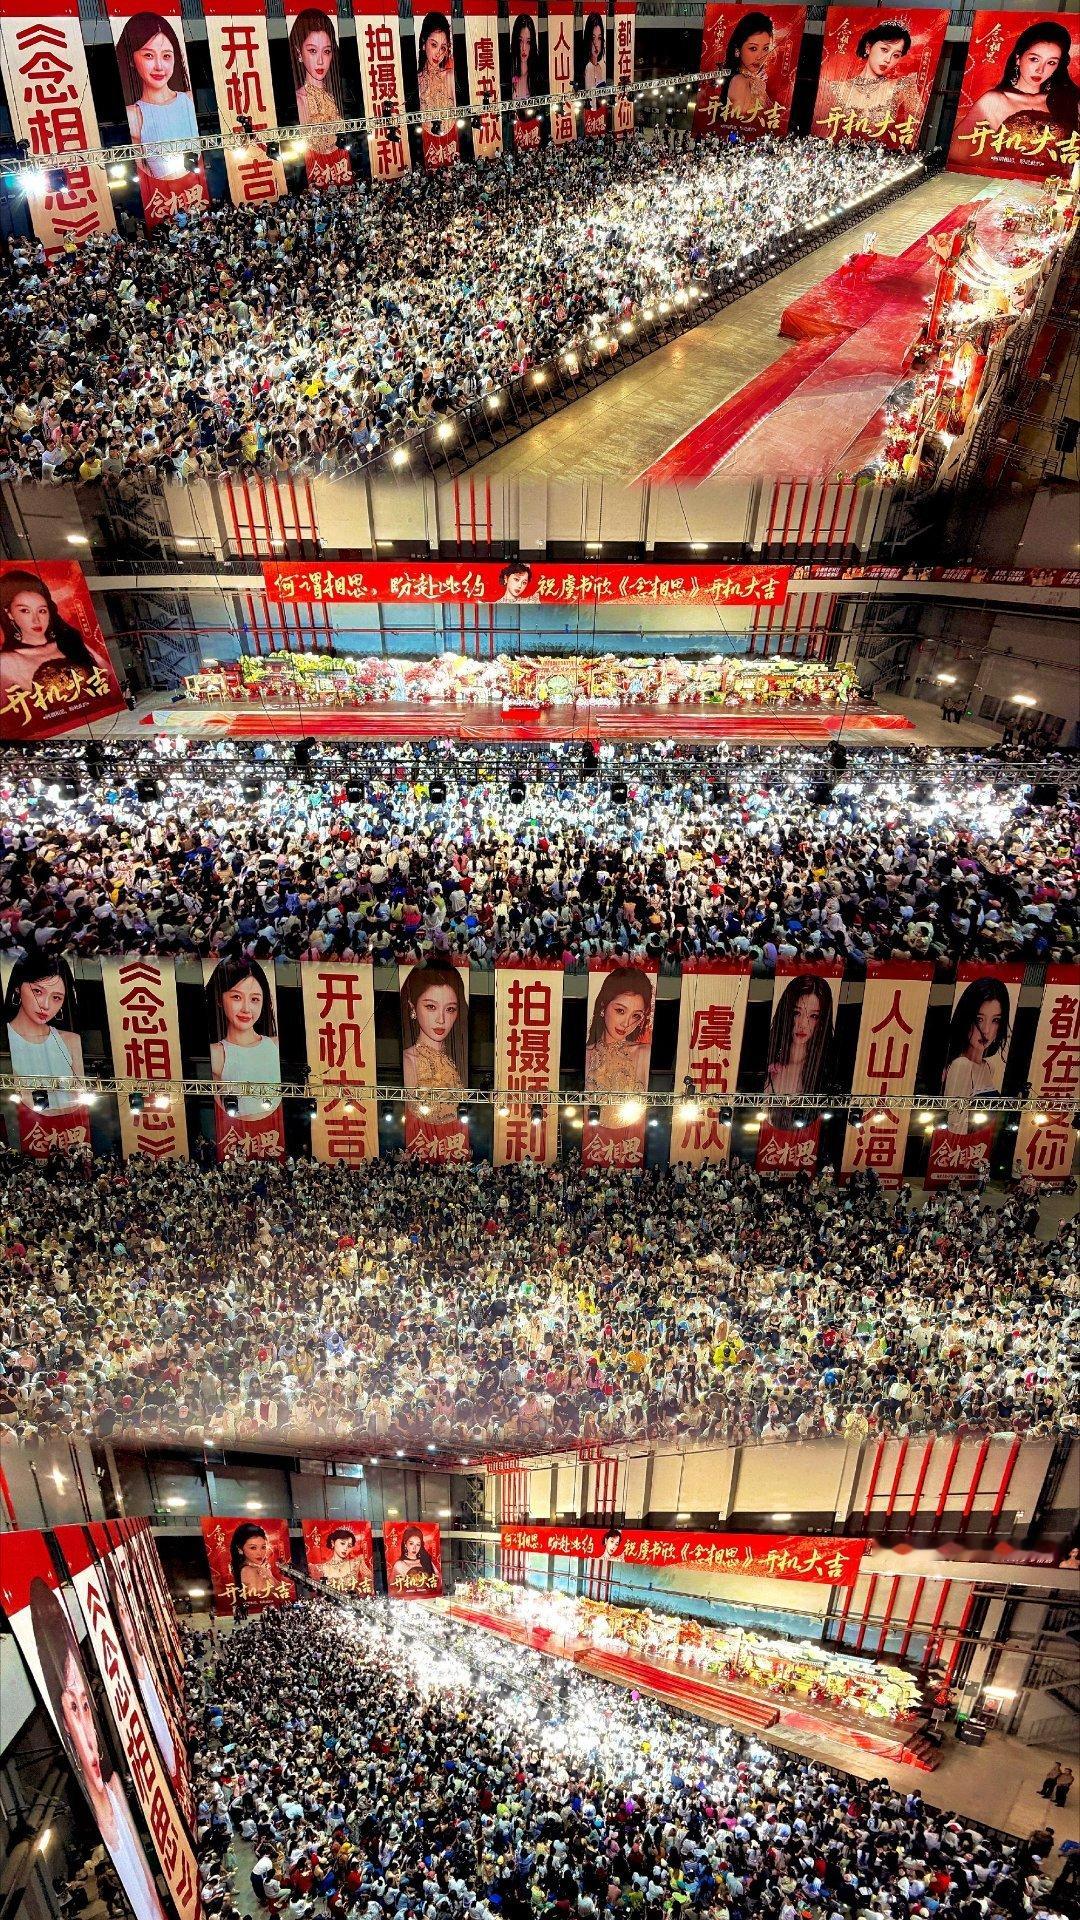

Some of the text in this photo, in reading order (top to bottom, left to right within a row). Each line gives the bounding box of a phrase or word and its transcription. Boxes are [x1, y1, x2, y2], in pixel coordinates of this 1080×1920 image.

[698, 95, 787, 130] 开机大吉
[816, 106, 922, 145] 开机大吉
[958, 120, 1080, 164] 开机大吉
[307, 157, 353, 187] 念相思
[145, 184, 210, 219] 念相思
[0, 665, 111, 727] 开机大吉
[316, 973, 366, 1158] 开机大吉
[506, 979, 552, 1163] 拍摄顺利
[680, 1004, 735, 1150] 虞书欣
[852, 989, 914, 1168] 人山人海
[22, 1121, 92, 1153] 念相思
[218, 1125, 286, 1158] 念相思
[405, 1129, 470, 1160] 念相思
[583, 1133, 644, 1165] 念相思
[759, 1135, 818, 1166] 念相思
[930, 1138, 990, 1168] 念相思
[217, 1580, 292, 1605] 开机大吉
[389, 1572, 439, 1593] 开机大吉
[87, 1581, 193, 1908] 《念相思》
